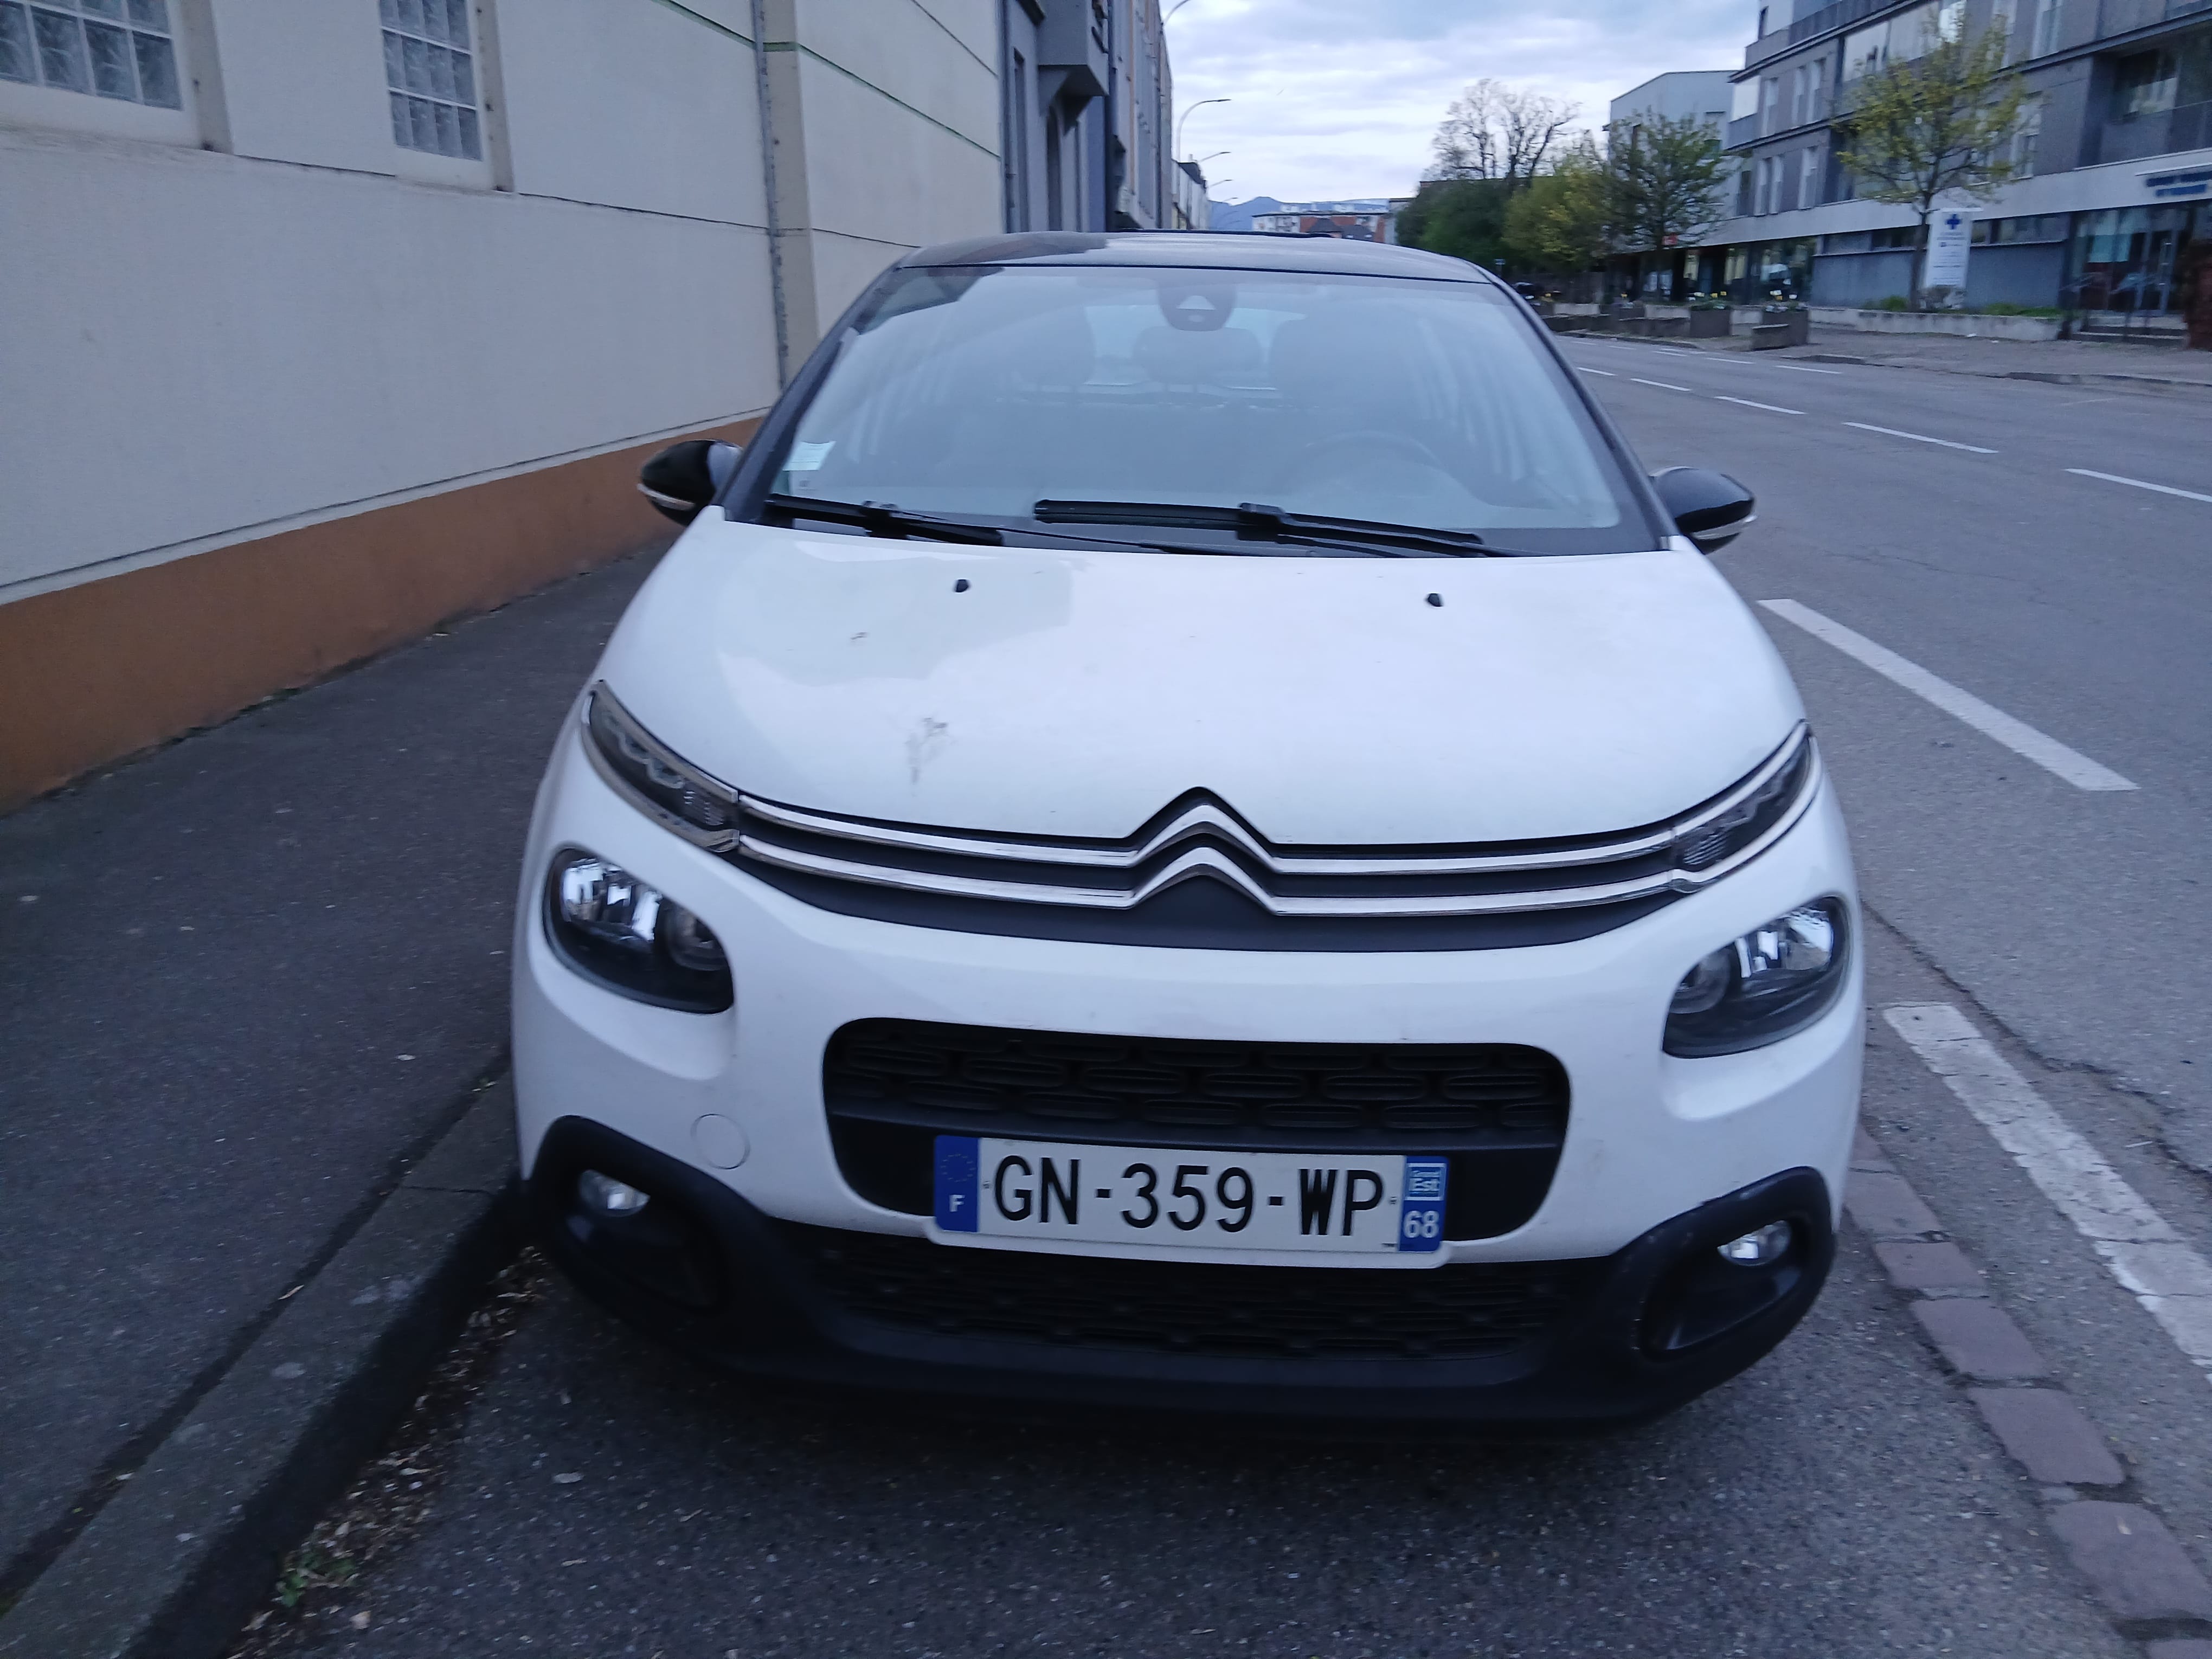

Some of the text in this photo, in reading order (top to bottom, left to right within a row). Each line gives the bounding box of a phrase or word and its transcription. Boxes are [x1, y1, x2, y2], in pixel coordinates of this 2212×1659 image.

[949, 1194, 966, 1212] F
[994, 1155, 1384, 1237] GN-359-WP
[1403, 1210, 1440, 1238] 68
